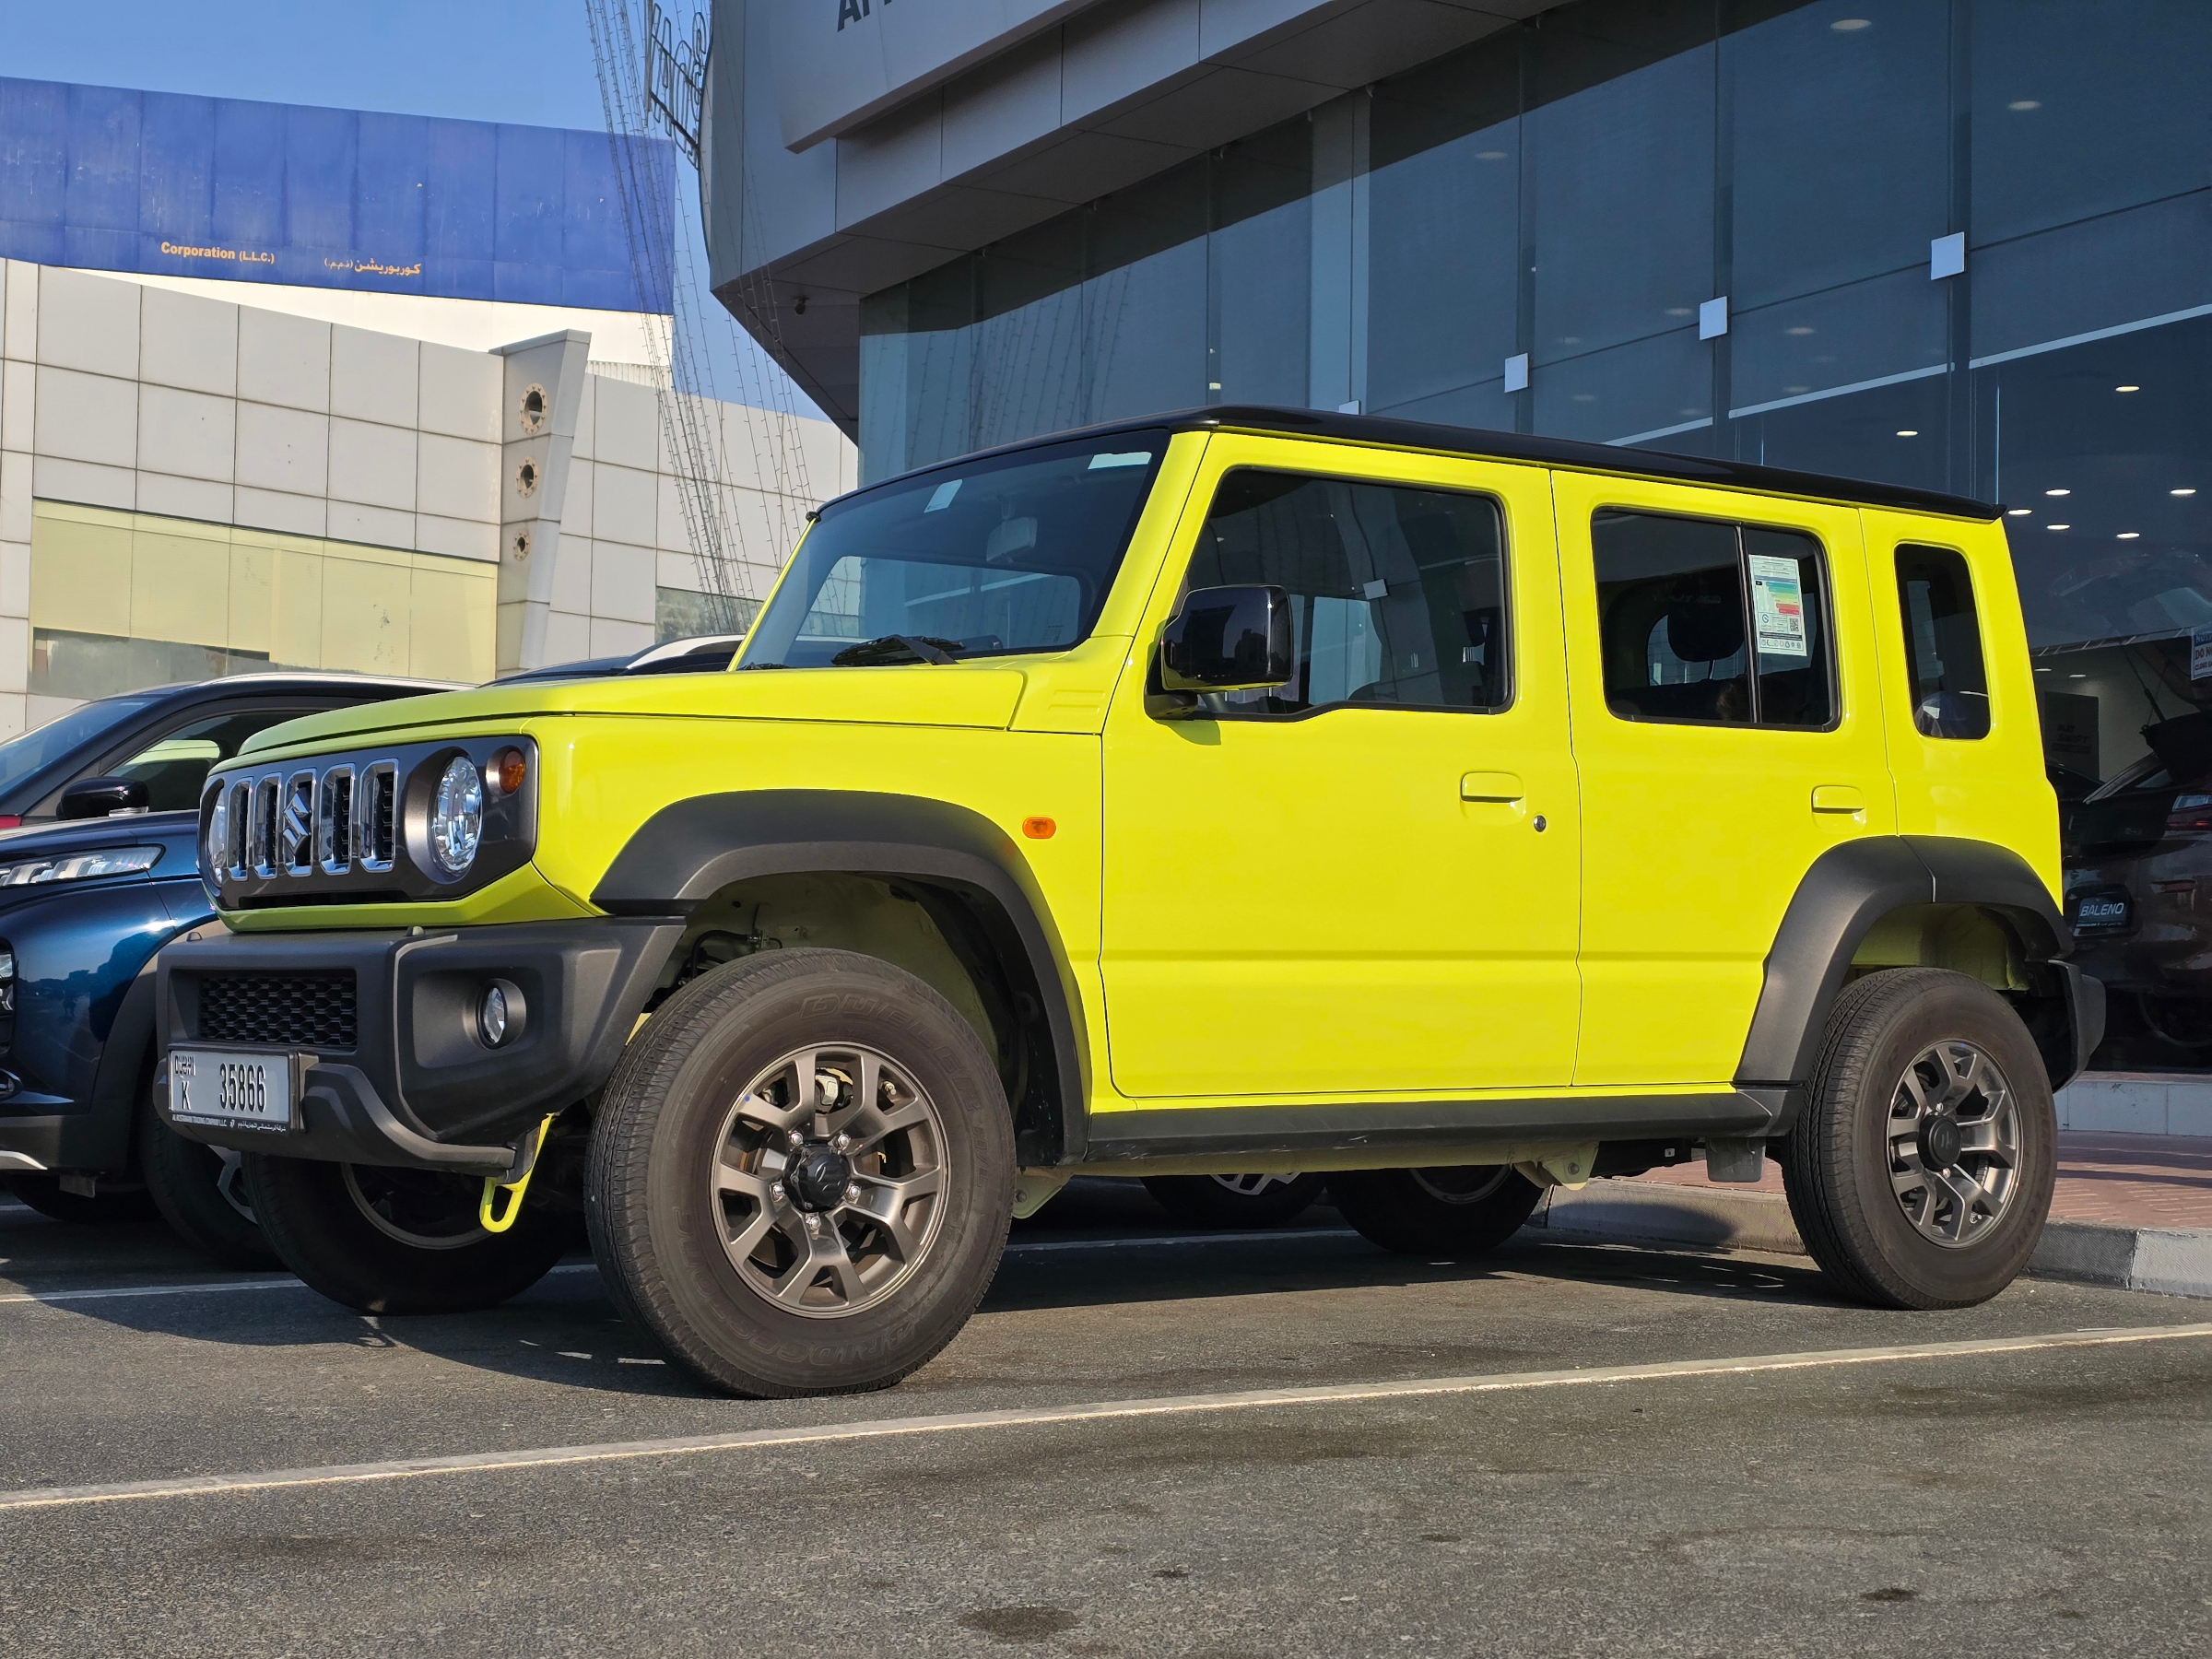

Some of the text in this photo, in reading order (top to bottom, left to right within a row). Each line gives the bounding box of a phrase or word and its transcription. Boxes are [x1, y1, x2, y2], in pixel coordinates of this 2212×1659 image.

[160, 241, 275, 265] Corporation (L.L.C.)
[354, 257, 421, 276] كوربوريشن
[2079, 902, 2124, 917] BALENO
[181, 1063, 266, 1113] K 35866
[672, 1206, 916, 1367] BRIDGESTONE
